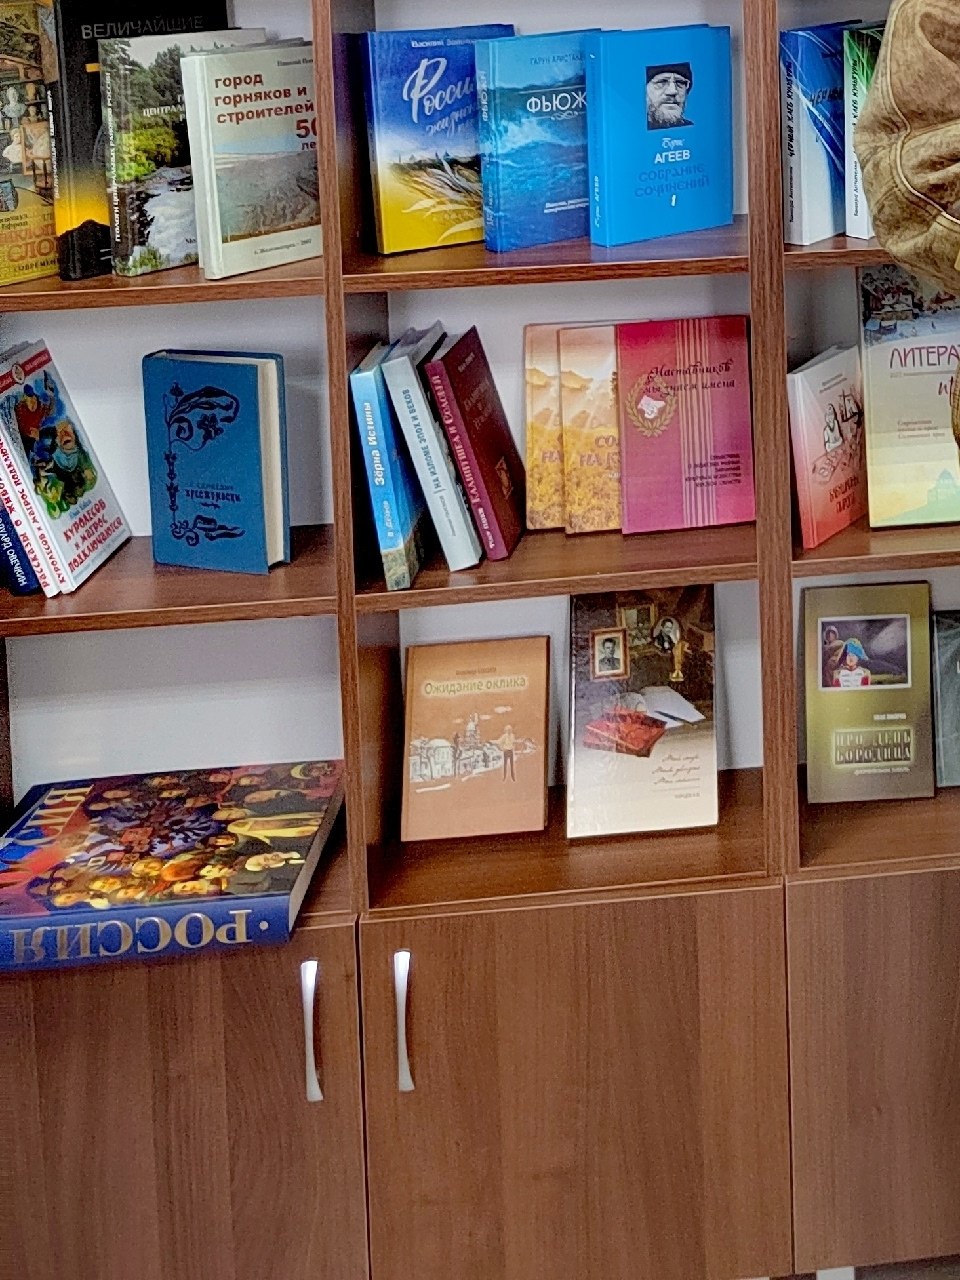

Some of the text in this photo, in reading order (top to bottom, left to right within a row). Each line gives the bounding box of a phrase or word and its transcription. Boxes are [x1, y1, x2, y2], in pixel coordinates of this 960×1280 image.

[215, 73, 263, 90] город
[214, 86, 307, 107] горняков и
[216, 100, 314, 125] строителей
[301, 141, 316, 151] ле
[654, 149, 691, 165] АГЕЕВ
[362, 401, 386, 487] Зёрна Истины
[7, 547, 28, 587] ОВЕЧКИН
[423, 674, 527, 696] Ожидание оклика
[8, 909, 253, 964] РОССИЯ
